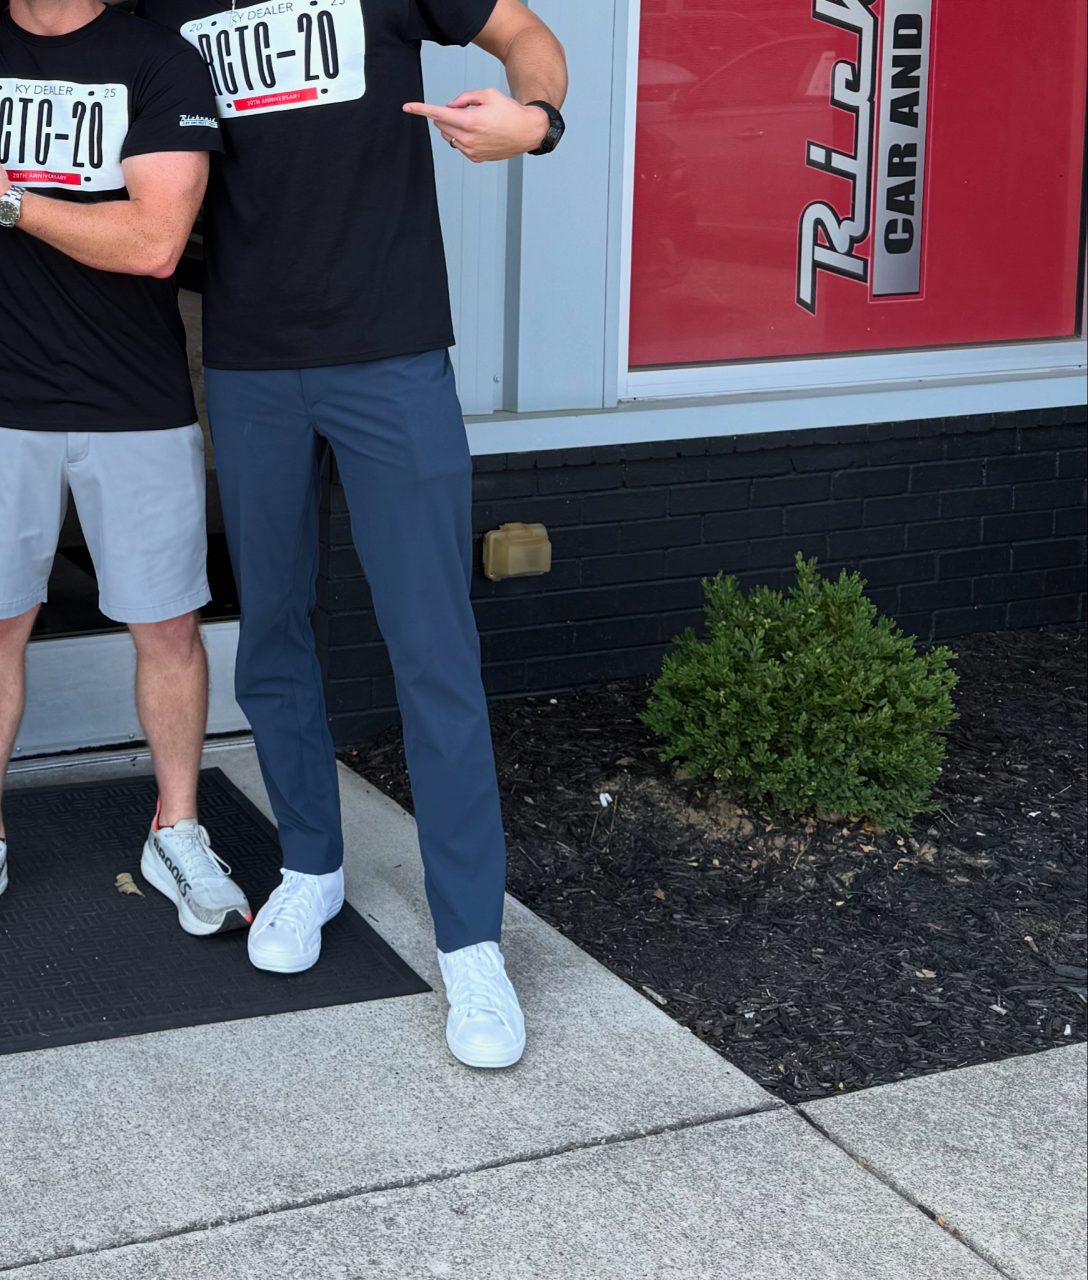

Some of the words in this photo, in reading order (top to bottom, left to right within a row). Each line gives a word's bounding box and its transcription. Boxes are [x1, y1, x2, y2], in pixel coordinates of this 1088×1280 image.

[189, 23, 202, 32] 20
[247, 2, 294, 21] DEALER
[198, 10, 340, 97] RCTC-20
[889, 13, 923, 128] AND
[15, 84, 32, 94] KY
[33, 85, 74, 96] DEALER
[103, 88, 117, 99] 25
[247, 98, 261, 107] 20TH
[262, 93, 301, 105] ANNIVERSARY
[884, 142, 918, 255] CAR
